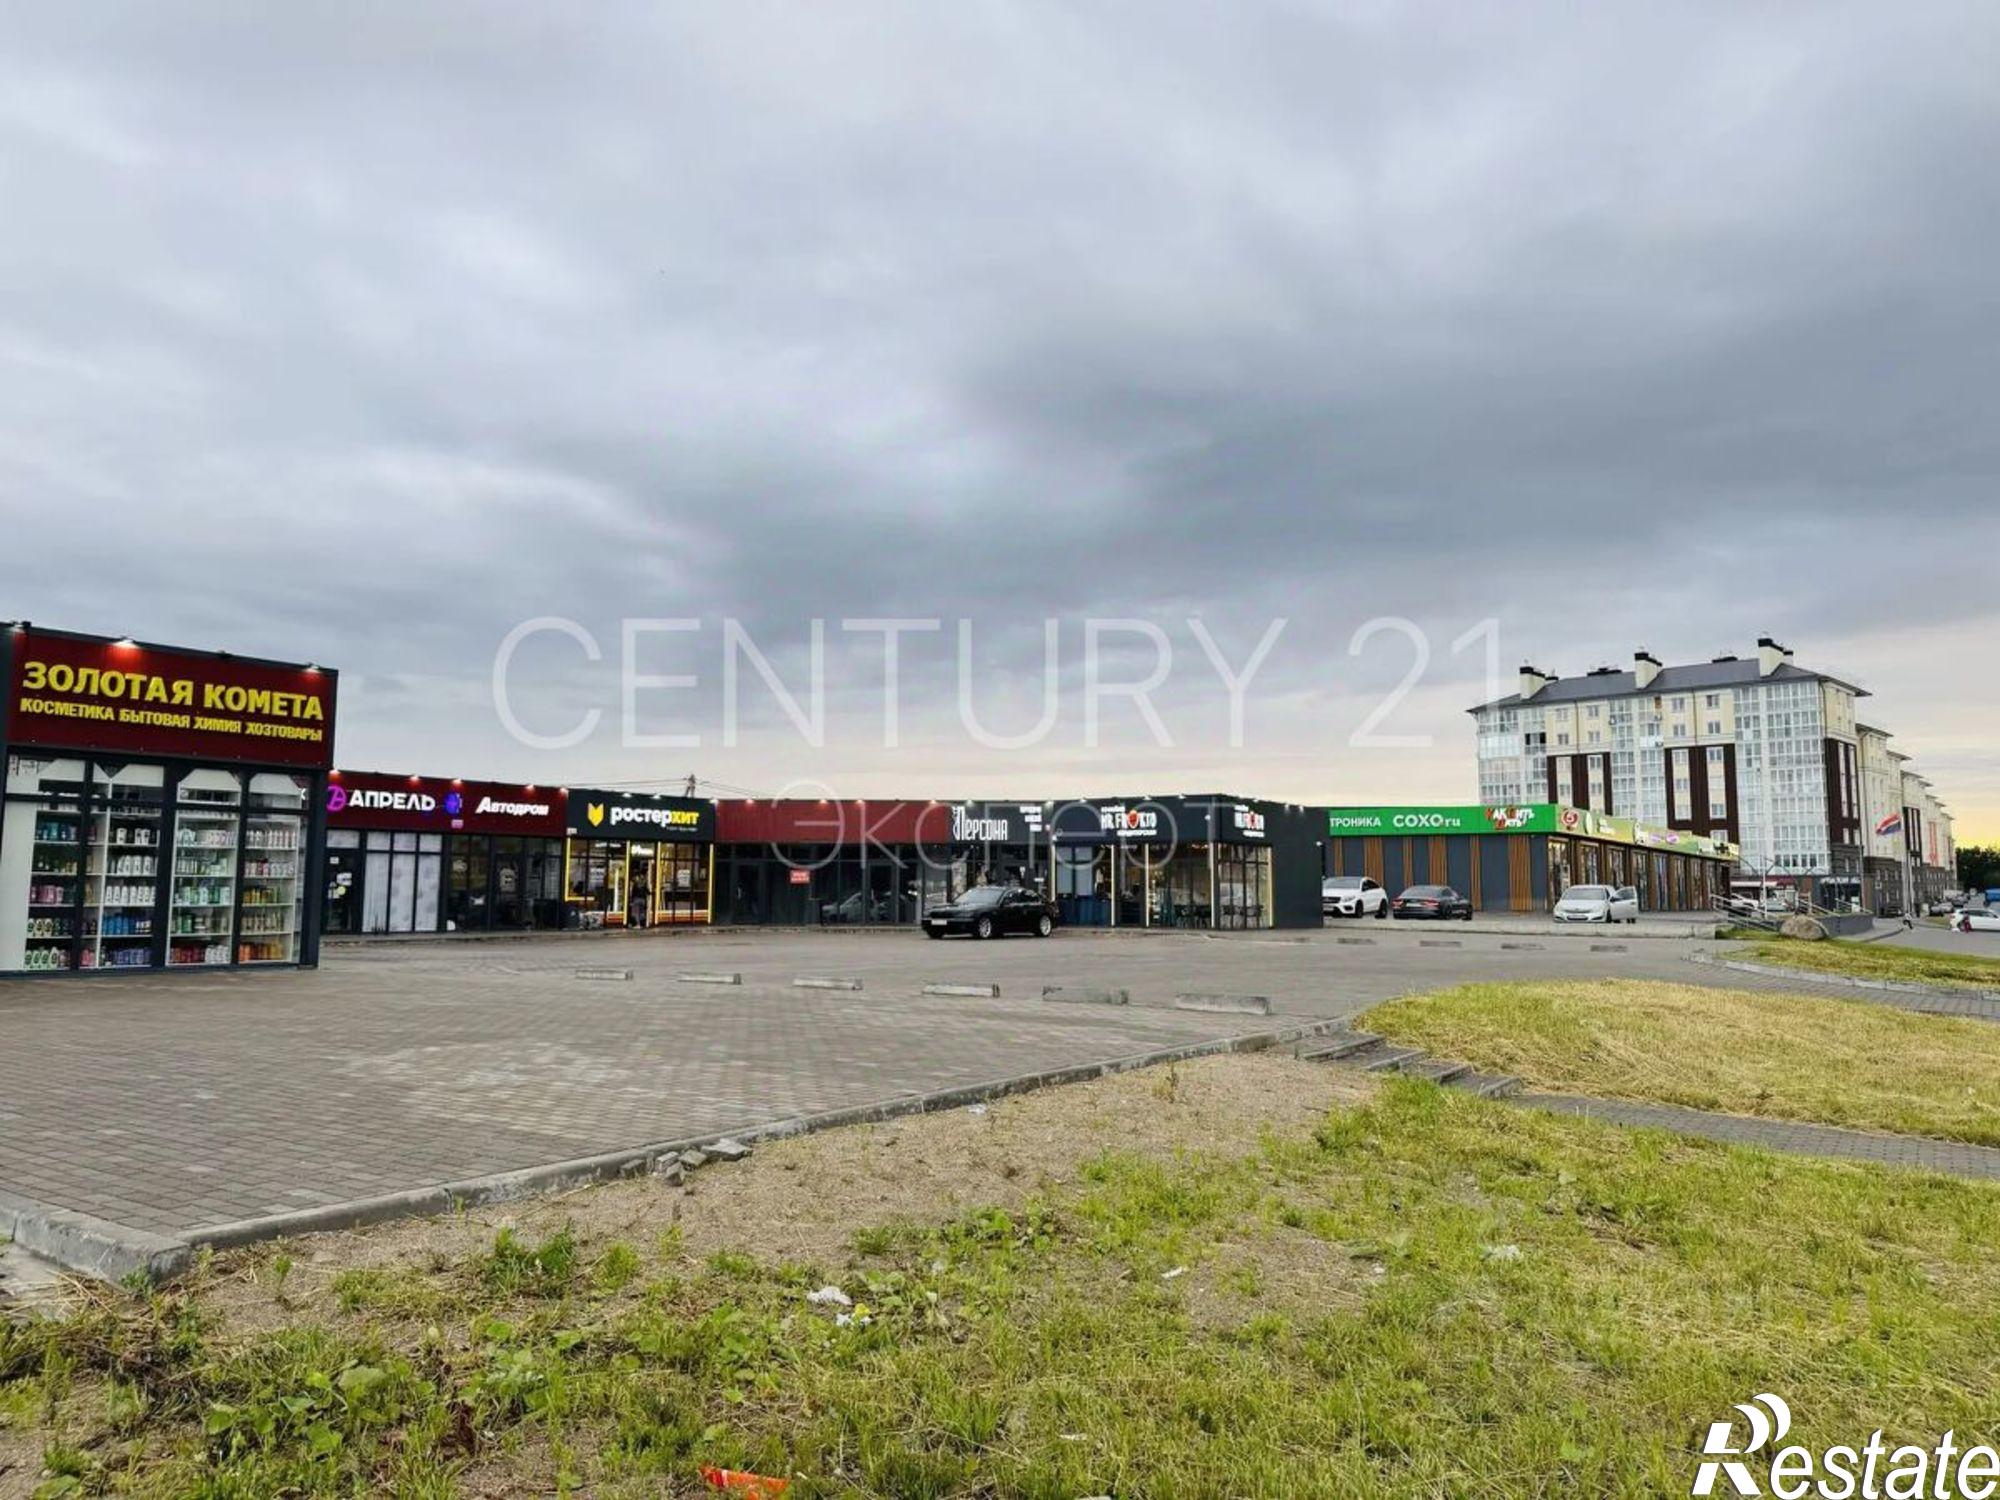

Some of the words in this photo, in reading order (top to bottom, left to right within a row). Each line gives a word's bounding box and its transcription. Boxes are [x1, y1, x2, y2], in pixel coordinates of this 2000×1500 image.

[22, 661, 194, 707] ЗОЛОТАЯ
[203, 684, 324, 721] КОМЕТА
[20, 697, 114, 721] КОСМЕТИКА
[119, 709, 190, 729] БЫТОВАЯ
[193, 717, 241, 734] ХИМИЯ
[245, 722, 323, 742] ХОЗТОВАРЫ
[348, 789, 436, 812] АПРЕЛЬ
[609, 806, 700, 828] ростерхит
